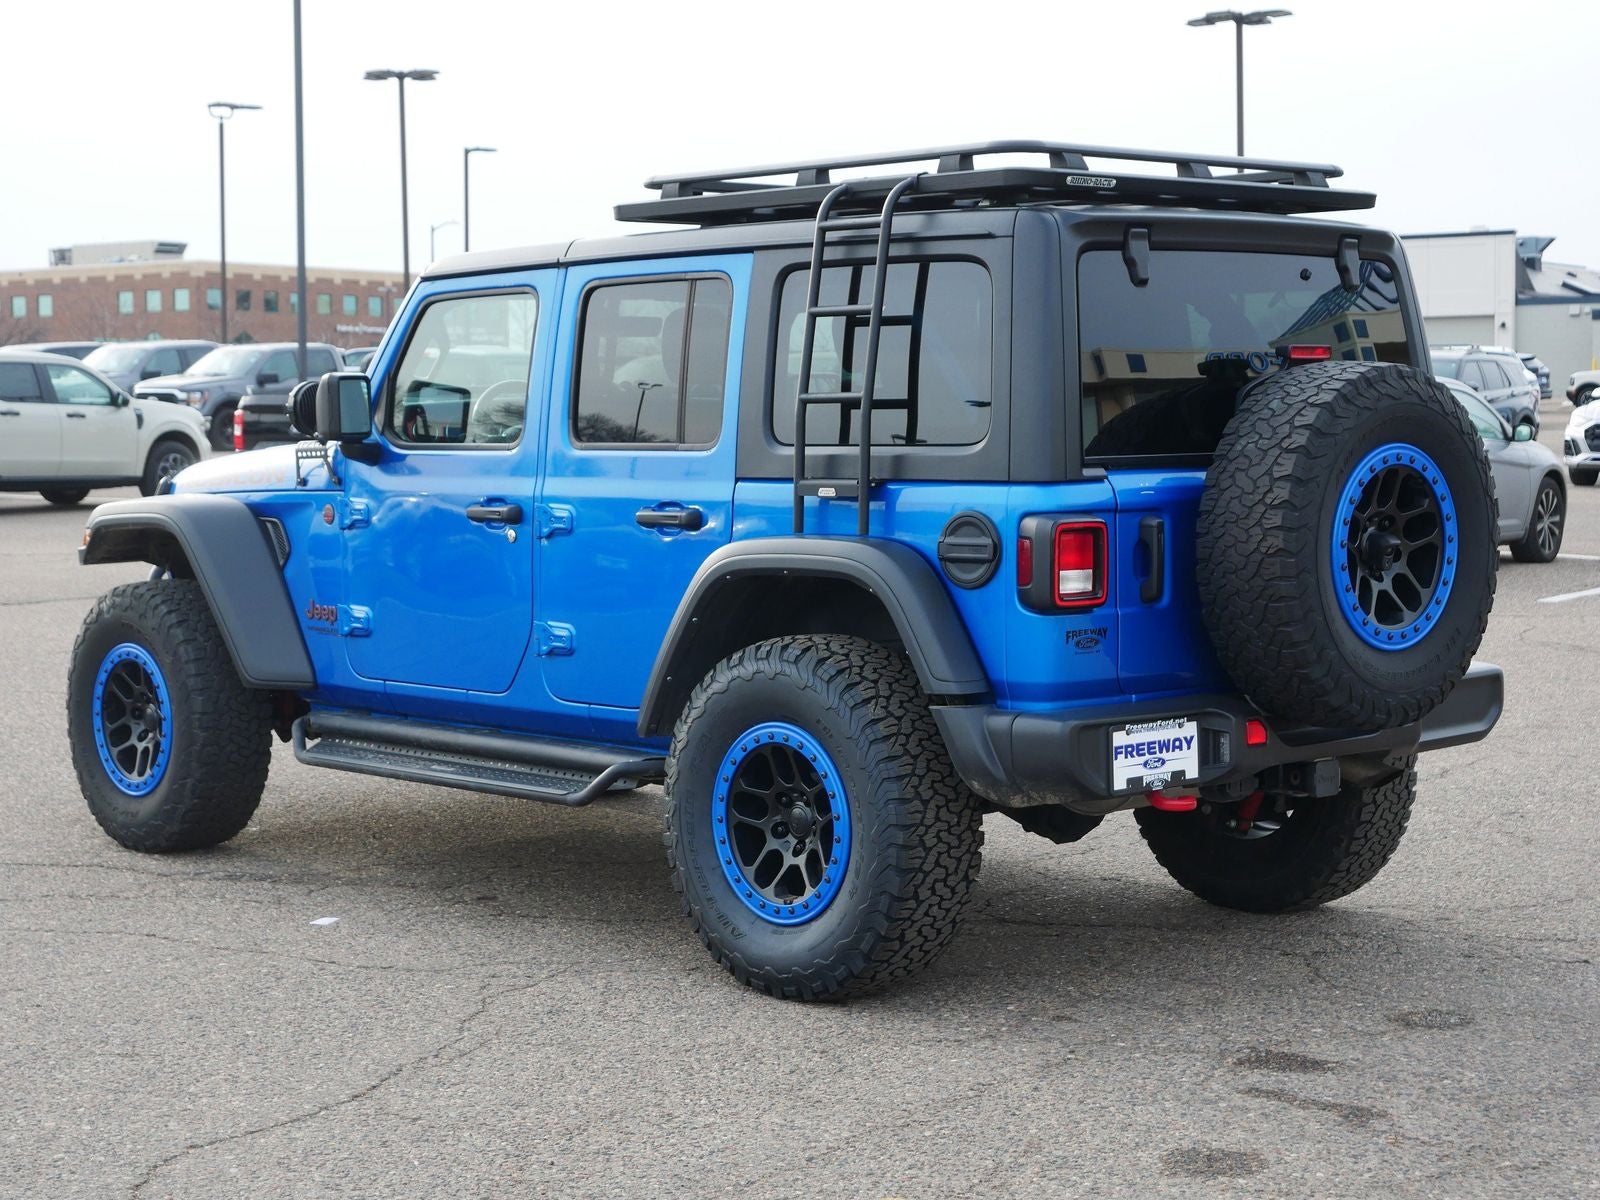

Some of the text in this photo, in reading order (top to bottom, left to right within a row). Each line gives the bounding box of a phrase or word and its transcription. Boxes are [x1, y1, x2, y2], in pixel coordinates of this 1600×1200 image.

[305, 599, 337, 624] Jeep
[1065, 626, 1108, 644] FREEWAY
[1113, 735, 1195, 761] FREEWAY
[1146, 758, 1163, 769] Ford
